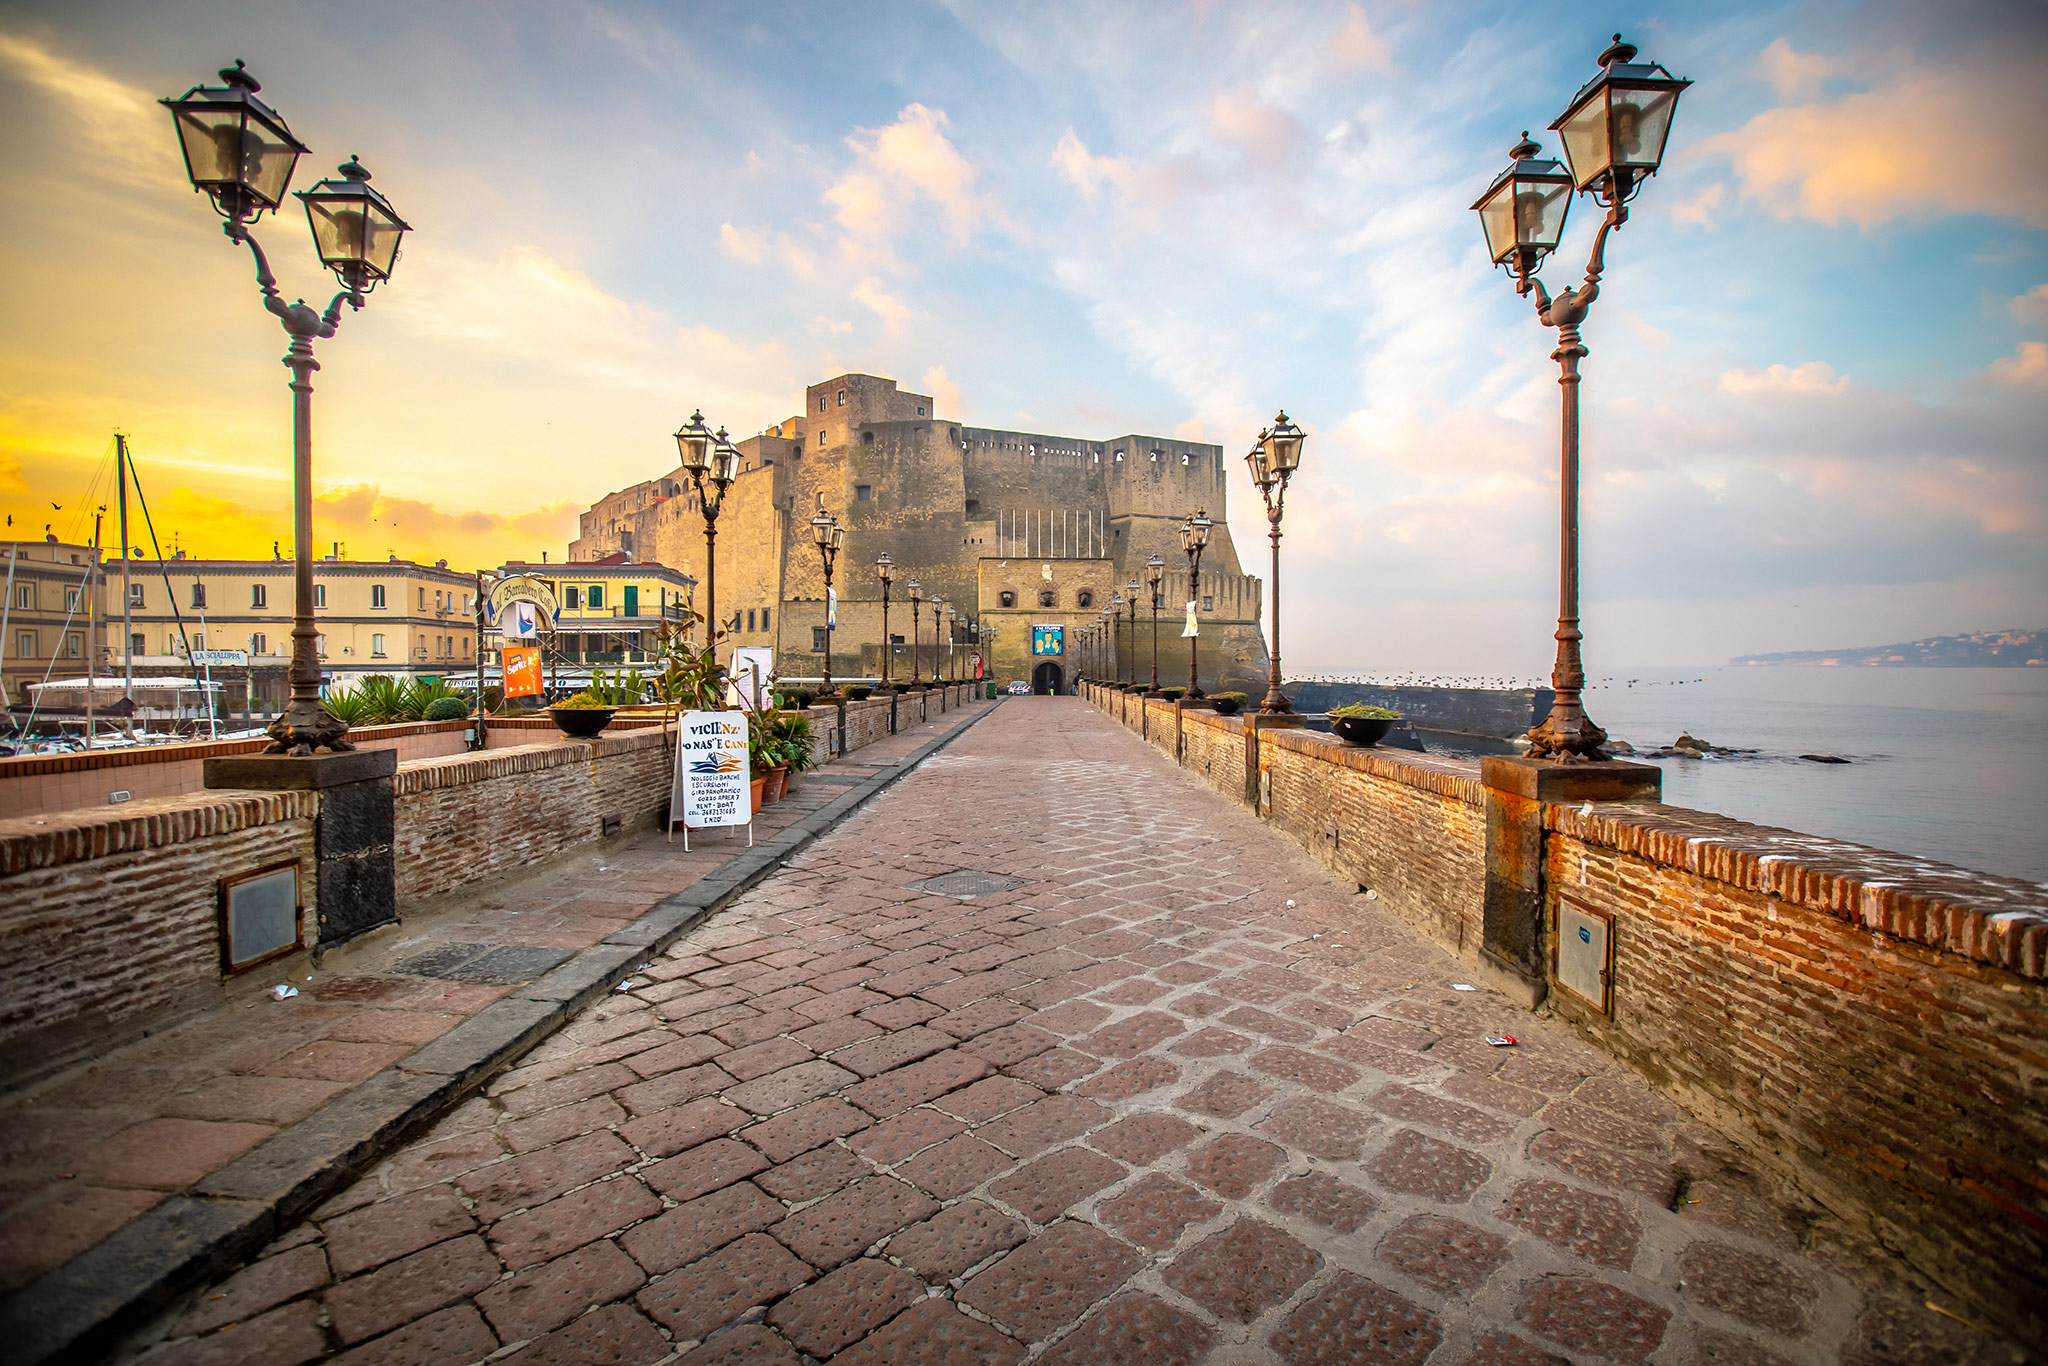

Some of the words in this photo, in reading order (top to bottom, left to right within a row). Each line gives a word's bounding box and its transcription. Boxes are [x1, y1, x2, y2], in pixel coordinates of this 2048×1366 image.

[194, 652, 204, 660] LA
[207, 652, 240, 660] SCIALUPPA
[507, 660, 527, 675] Spritz
[695, 802, 712, 810] RENT
[716, 801, 734, 809] BOAT
